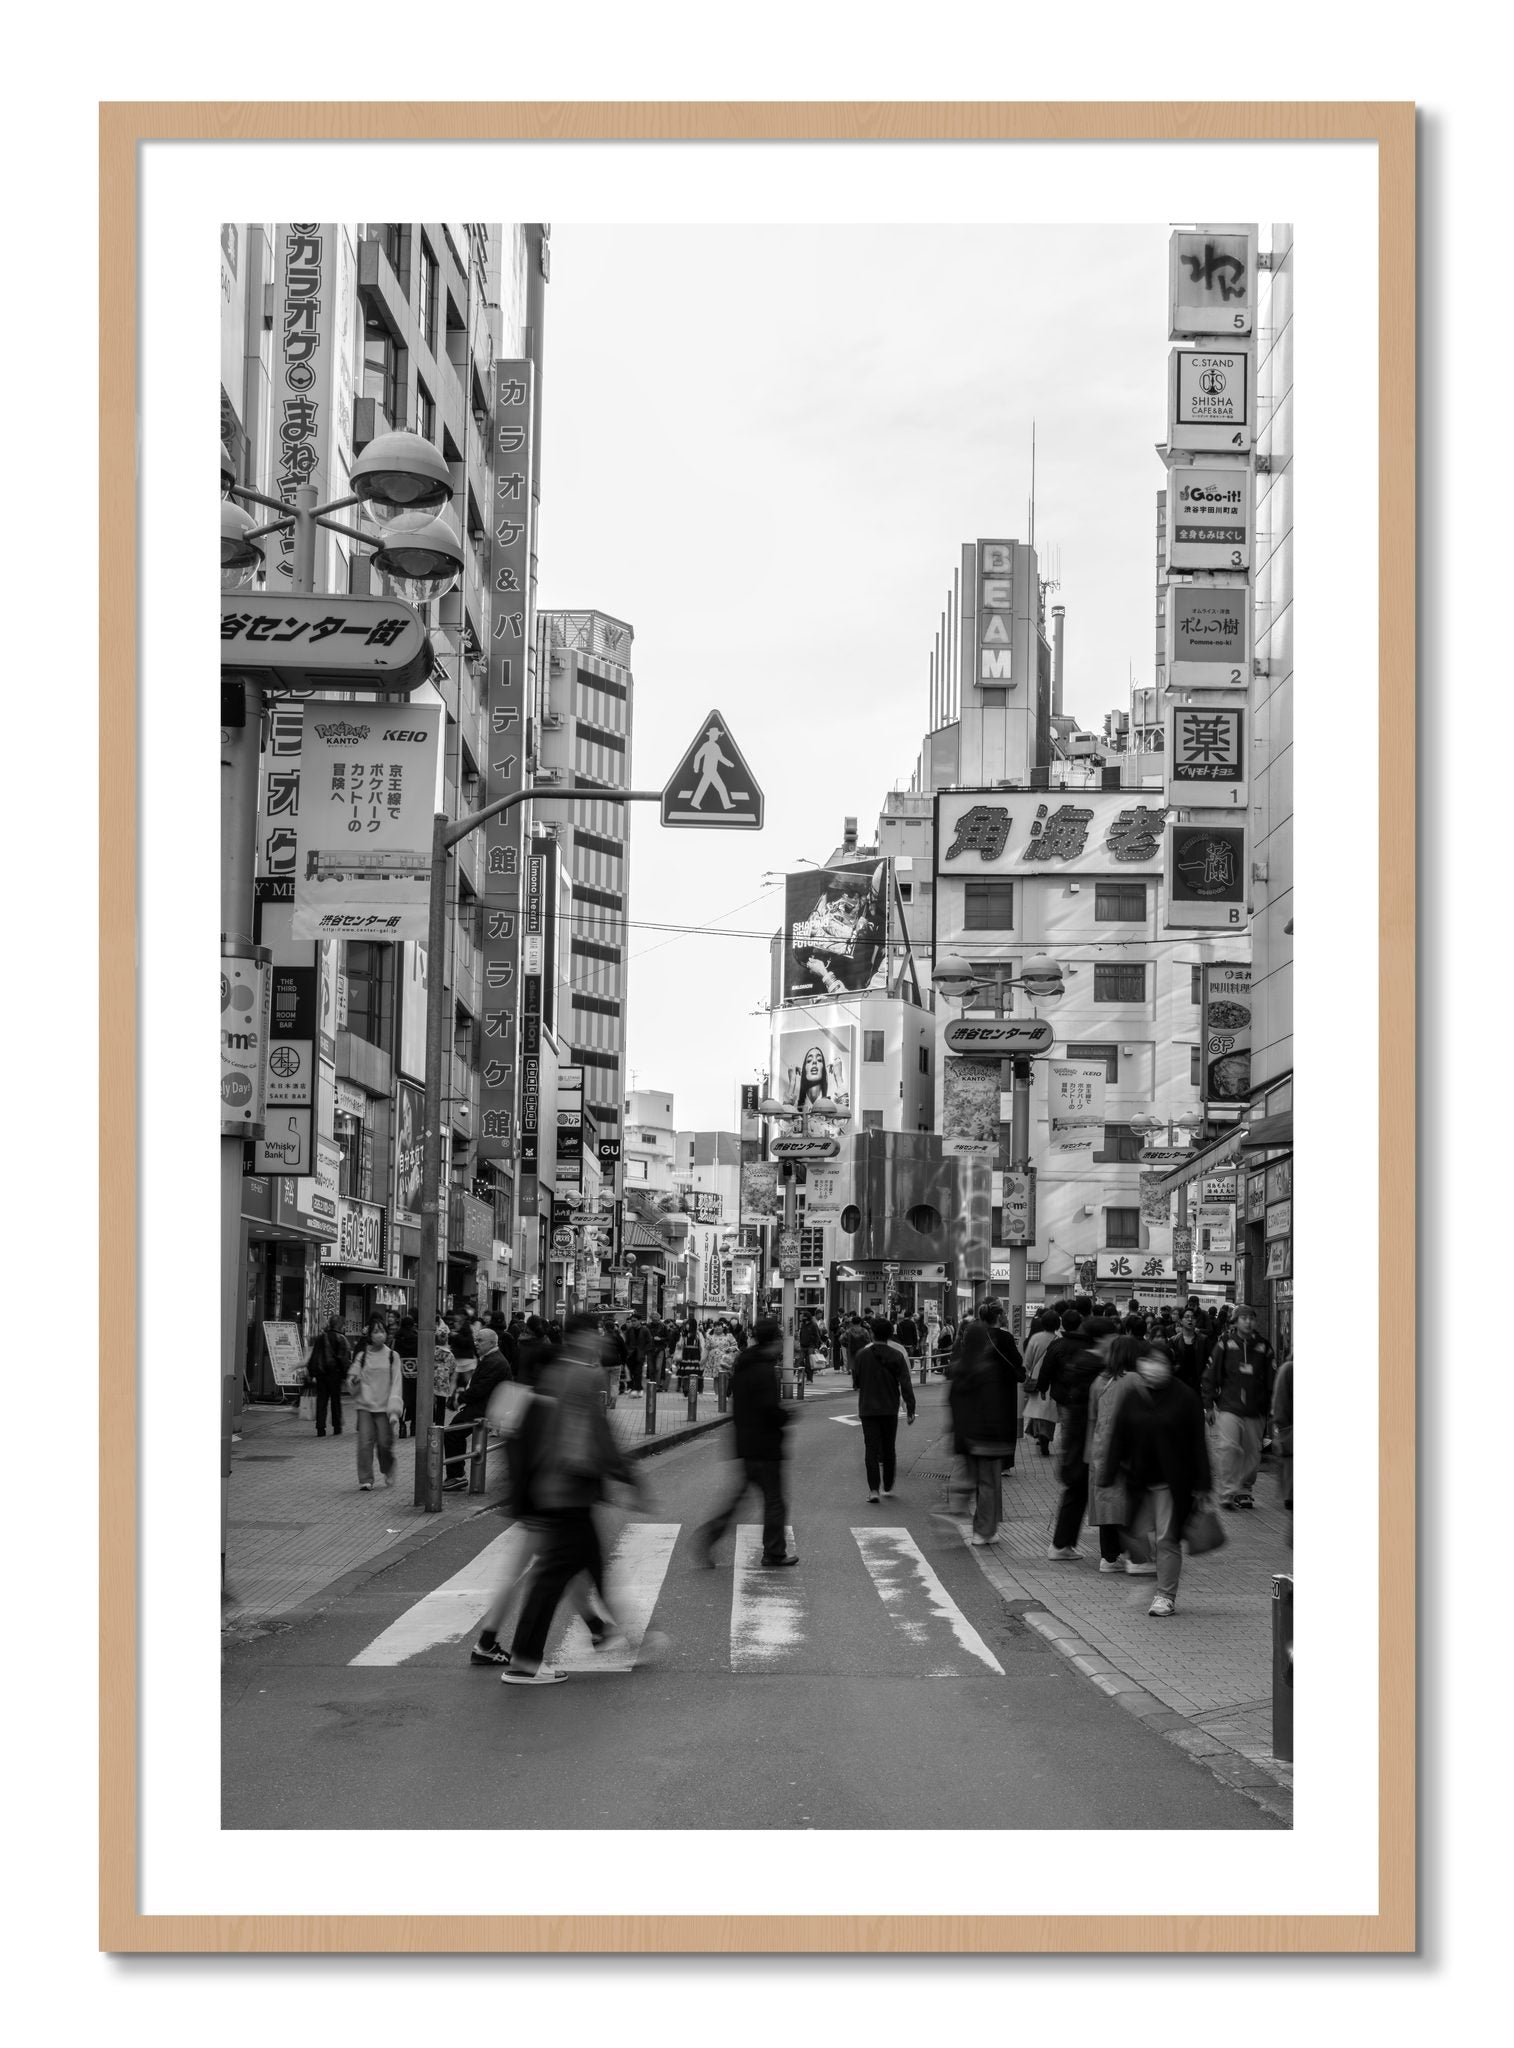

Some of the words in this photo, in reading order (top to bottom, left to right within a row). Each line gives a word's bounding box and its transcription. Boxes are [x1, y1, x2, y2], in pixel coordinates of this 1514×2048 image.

[283, 235, 322, 365] カラオケ
[1234, 315, 1244, 328] 5
[1192, 358, 1234, 368] C.STAND
[1192, 396, 1233, 406] SHISHA
[1192, 407, 1233, 415] CAFE&BAR
[1232, 432, 1243, 447] 4
[1190, 487, 1241, 502] Goo-it!
[1179, 529, 1242, 540] 全身もみほぐし
[1231, 550, 1242, 566] 3
[981, 544, 1012, 679] BEAM
[1180, 617, 1240, 635] ポムの樹
[1190, 638, 1232, 646] Pomme-no-ki
[1230, 669, 1241, 684] 2
[326, 737, 359, 745] KANTO
[382, 729, 427, 743] KEIO
[1183, 714, 1230, 762] 薬
[1178, 765, 1235, 778] マツモトキヨシ
[331, 763, 346, 803] 冒険へ
[347, 763, 365, 833] カントーの
[386, 764, 403, 820] 京王線で
[1230, 789, 1238, 803] 1
[945, 804, 1170, 861] 角海老
[1178, 841, 1235, 886] 一蘭
[530, 860, 539, 893] kimono
[319, 915, 402, 927] 渋谷センター街
[1229, 909, 1240, 923] B
[951, 1028, 1048, 1041] 渋谷センター街
[1208, 1036, 1235, 1054] 6F
[265, 1142, 296, 1152] Whisky
[600, 1145, 619, 1155] GU
[773, 1142, 832, 1151] 渋谷センター街
[264, 1151, 283, 1159] Bank
[1109, 1256, 1165, 1276] 兆楽
[711, 1254, 720, 1295] BEER
